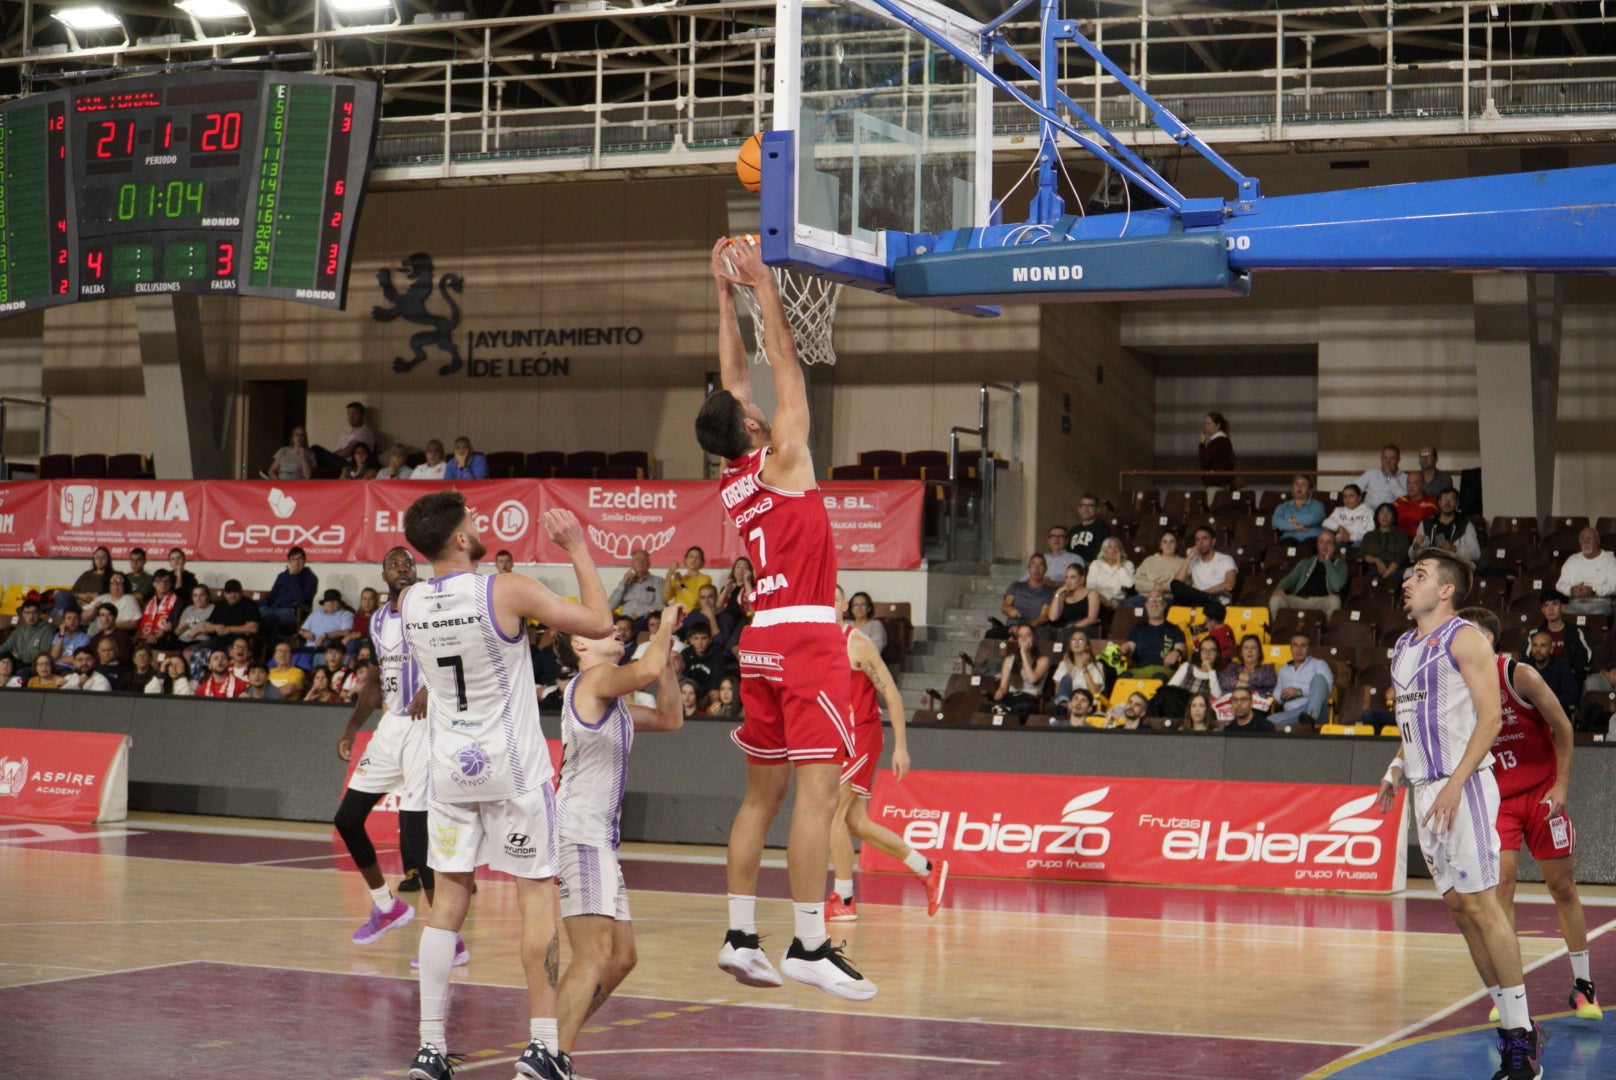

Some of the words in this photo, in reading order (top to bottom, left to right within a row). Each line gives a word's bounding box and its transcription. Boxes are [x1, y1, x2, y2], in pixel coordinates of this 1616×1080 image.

[276, 100, 285, 114] 5
[343, 102, 353, 116] 4
[49, 115, 65, 131] 12
[274, 115, 283, 130] 6
[341, 116, 352, 132] 3
[164, 122, 172, 149] 1
[201, 112, 241, 151] 20
[275, 131, 282, 145] 7
[96, 121, 135, 158] 21
[145, 155, 178, 166] PERIODO
[264, 146, 280, 160] 11
[262, 162, 279, 177] 13
[260, 178, 277, 192] 14
[333, 179, 345, 196] 6
[118, 180, 203, 220] 01:04
[258, 193, 275, 208] 15
[201, 217, 240, 227] MONDO
[257, 209, 273, 224] 16
[330, 211, 343, 228] 2
[57, 219, 66, 233] 4
[255, 224, 272, 239] 22
[253, 240, 271, 255] 24
[328, 243, 339, 259] 3
[58, 249, 68, 264] 2
[217, 244, 234, 276] 3
[253, 255, 269, 271] 35
[86, 252, 103, 278] 4
[325, 259, 337, 275] 2
[1012, 265, 1084, 282] MONDO
[59, 279, 69, 294] 2
[81, 285, 106, 295] FALTAS
[135, 281, 181, 293] EXCLUSIONES
[210, 279, 236, 290] FALTAS
[296, 288, 336, 300] MONDO
[0, 301, 26, 312] ONDO
[474, 326, 643, 349] AYUNTAMIENTO
[473, 358, 503, 378] DE
[508, 352, 570, 377] LEÓN
[588, 486, 677, 509] Ezedent
[101, 490, 190, 522] IXMA
[735, 497, 773, 529] eoxa
[602, 513, 624, 522] Smile
[624, 513, 663, 524] Designers
[219, 519, 346, 549] Geoxa
[749, 526, 767, 568] 7
[406, 622, 429, 630] KYLE
[432, 615, 483, 628] GREELEY
[386, 677, 398, 692] 35
[437, 655, 468, 712] 7
[1402, 722, 1412, 743] 11
[1497, 750, 1517, 770] 13
[32, 771, 95, 785] ASPIRE
[36, 786, 81, 795] ACADEMY
[882, 805, 941, 819] Frutas
[1139, 814, 1201, 829] Frutas
[902, 811, 951, 851] el
[953, 812, 1111, 857] bierzo
[504, 844, 537, 854] HYUNDAI
[1162, 821, 1211, 860] el
[1216, 821, 1382, 866] bierzo
[1026, 859, 1063, 869] grupo
[1295, 869, 1333, 880] grupo
